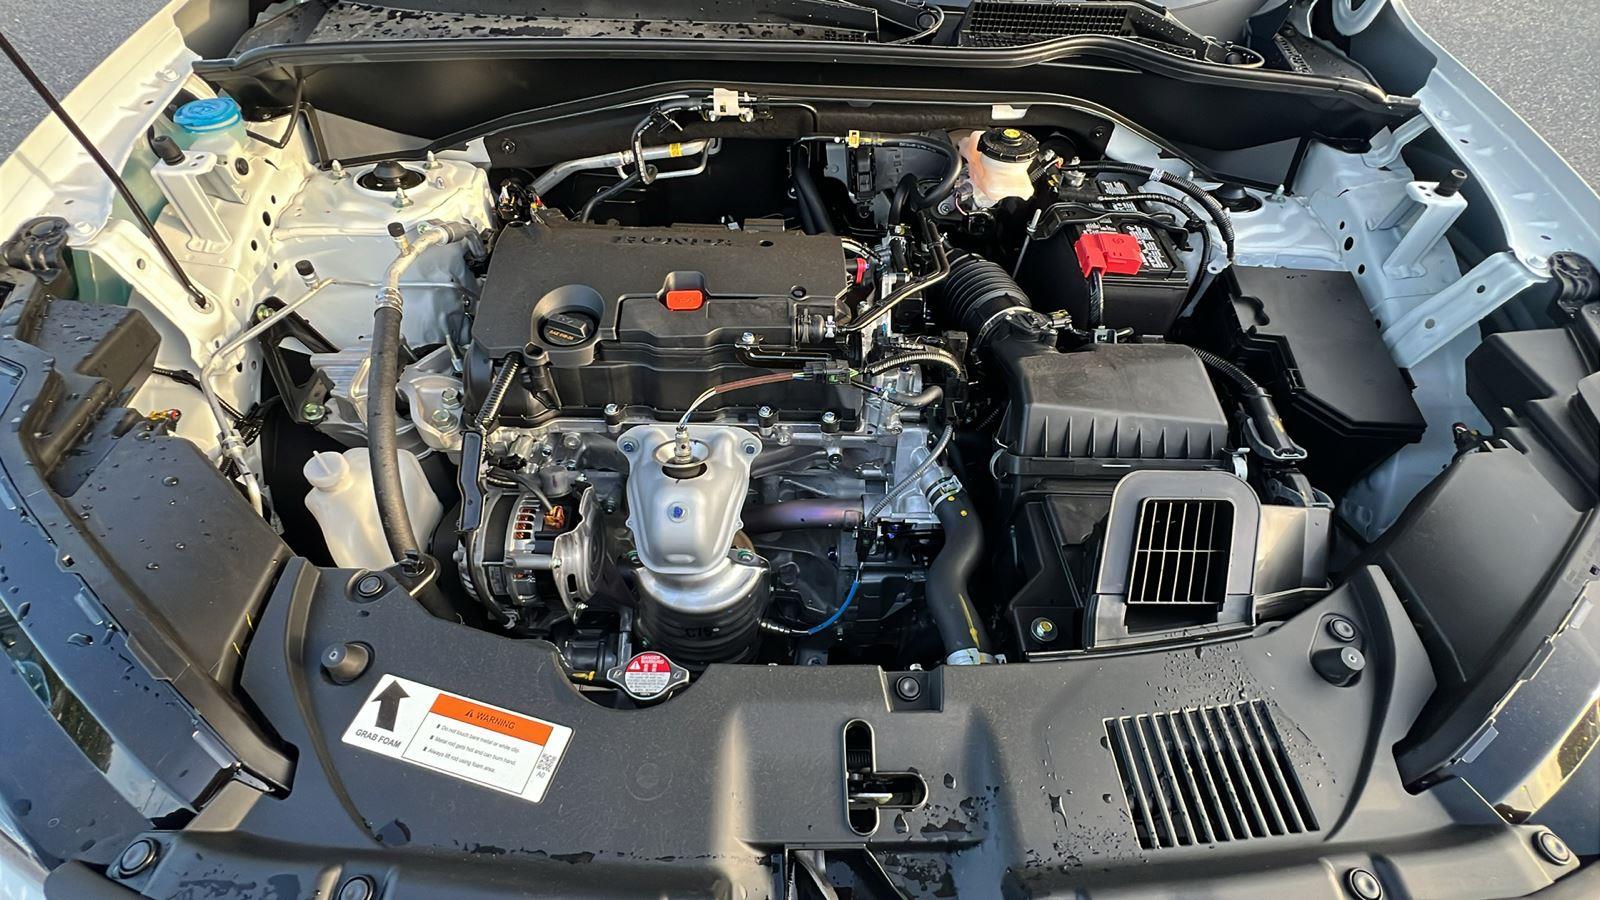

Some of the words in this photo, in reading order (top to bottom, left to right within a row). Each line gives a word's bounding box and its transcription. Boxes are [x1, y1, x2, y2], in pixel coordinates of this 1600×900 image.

[476, 712, 516, 730] WARNING
[355, 729, 378, 742] GRAB
[379, 736, 402, 748] FOAM
[434, 736, 448, 744] Metal
[428, 748, 444, 757] Always
